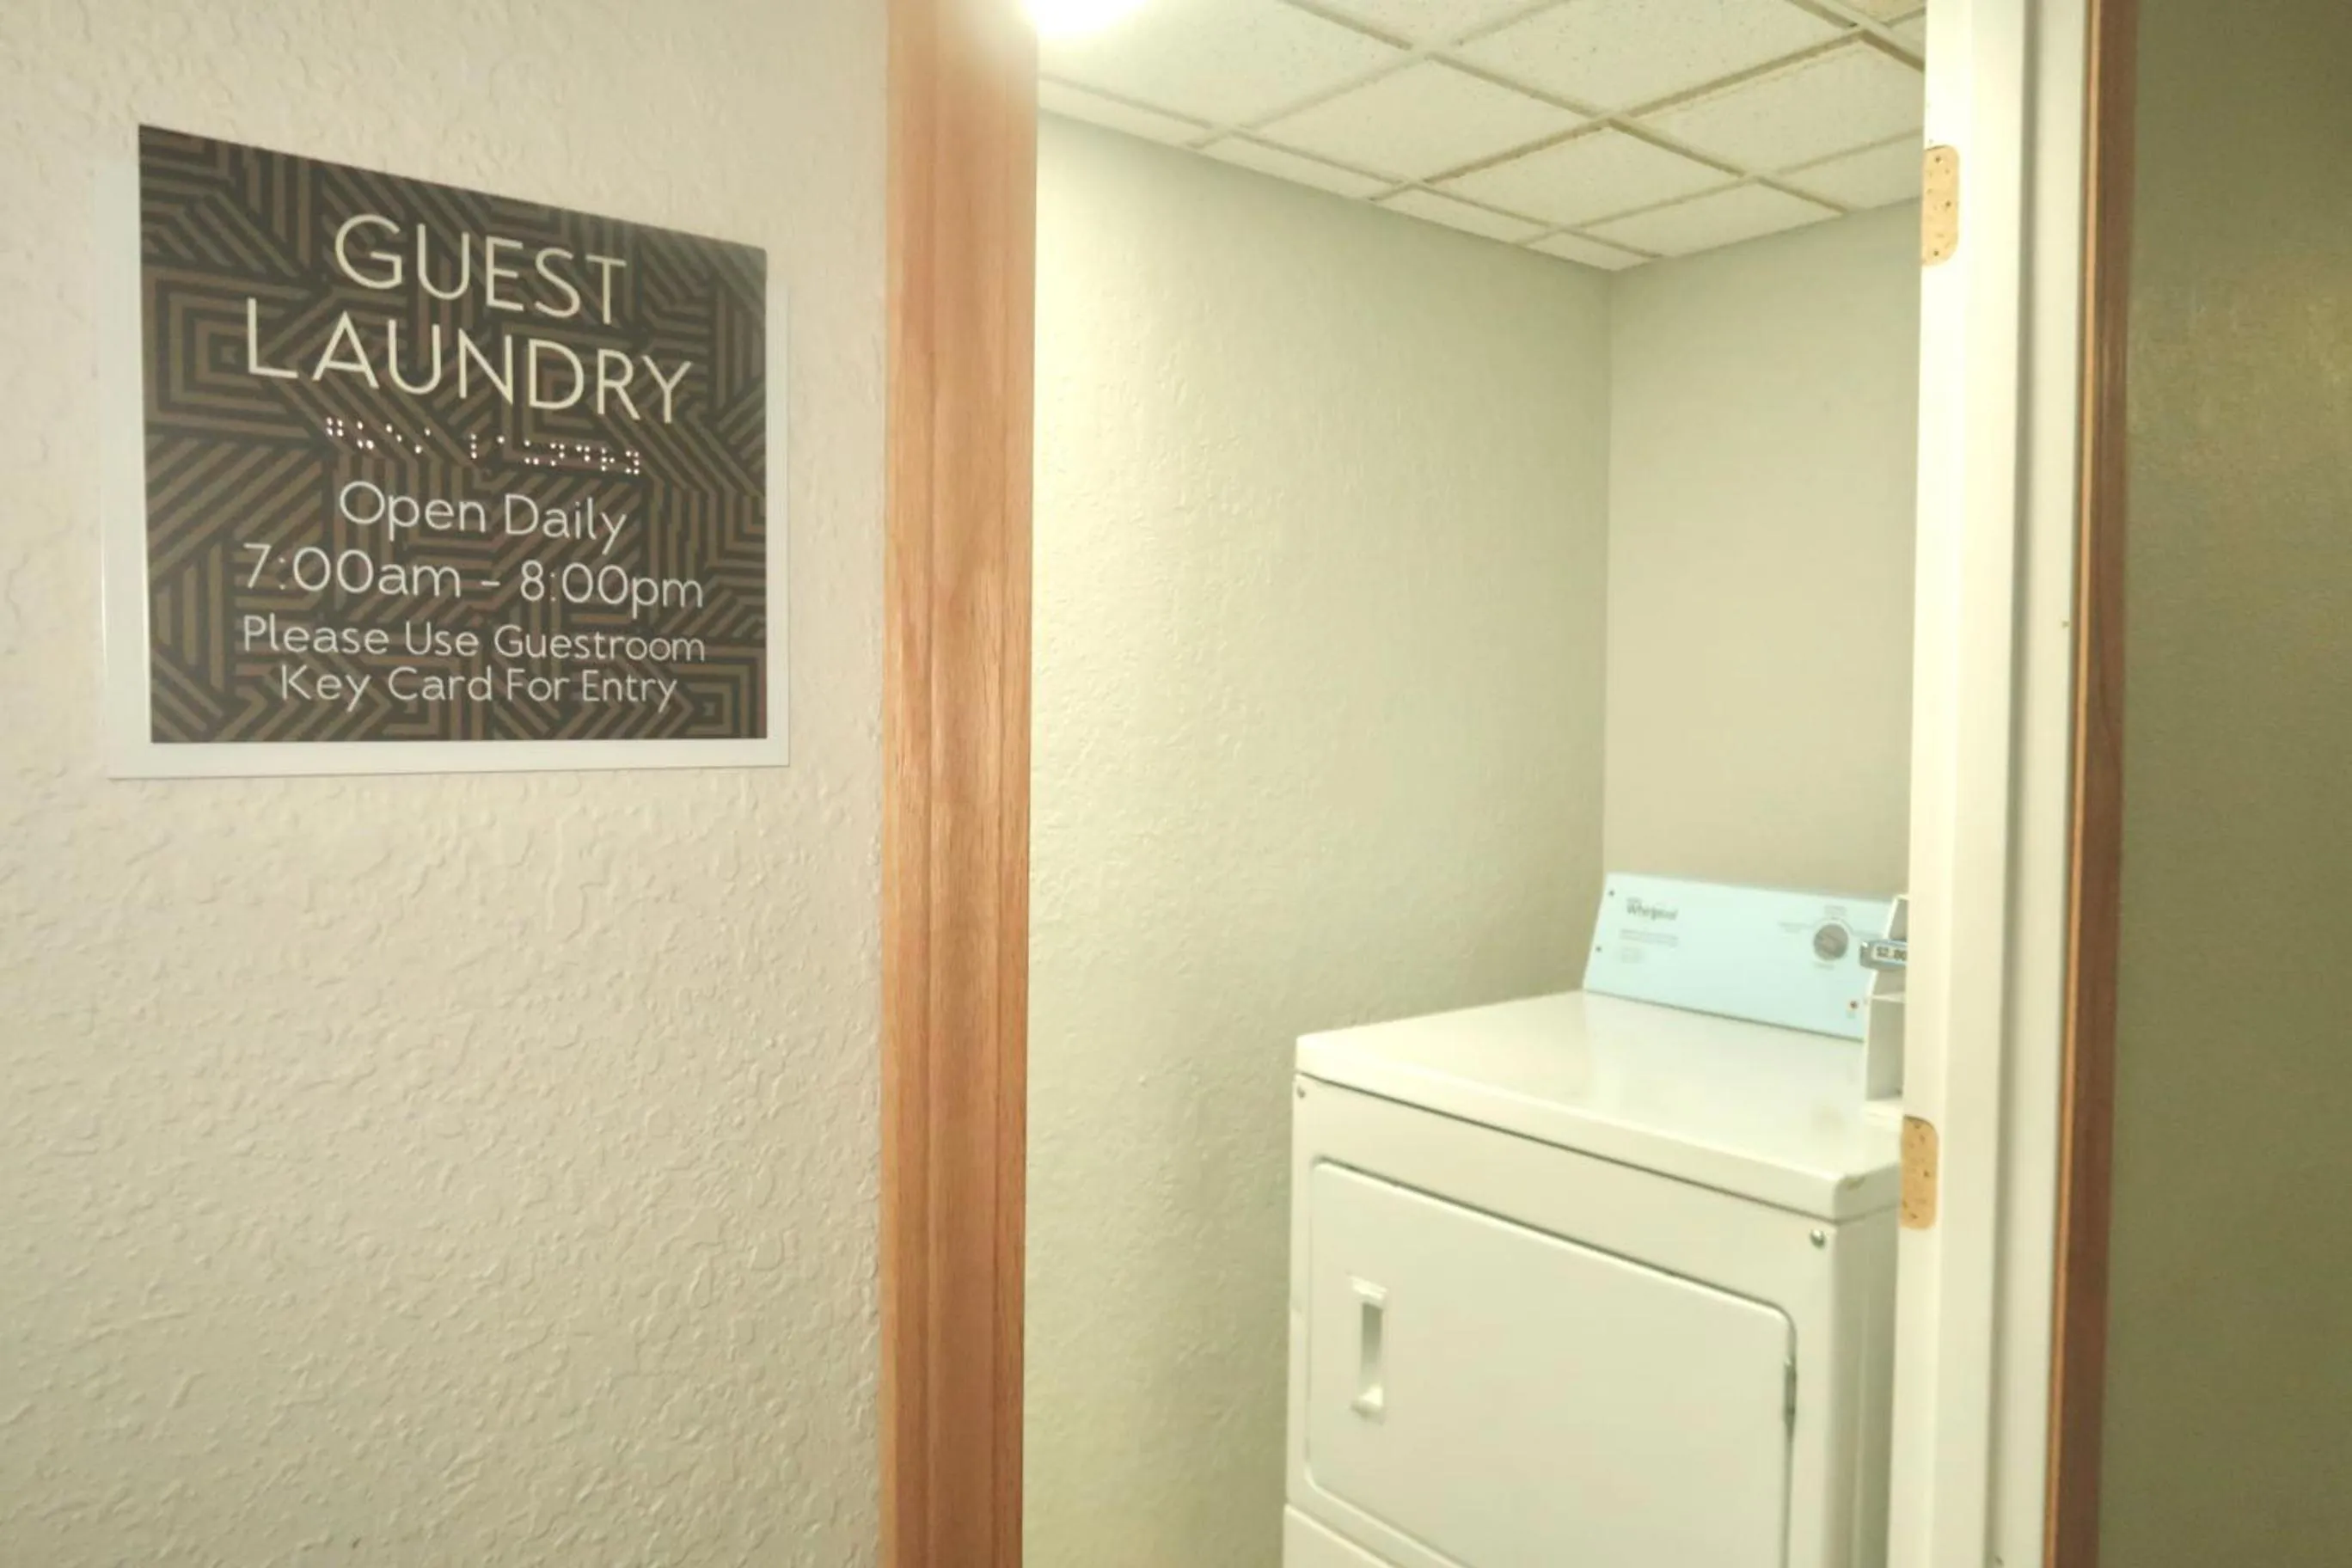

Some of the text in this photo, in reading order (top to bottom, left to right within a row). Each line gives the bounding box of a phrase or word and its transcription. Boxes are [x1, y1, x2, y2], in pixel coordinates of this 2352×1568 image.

[334, 212, 628, 325] GUEST
[246, 297, 693, 424] LAUNDRY
[339, 479, 628, 555] Open Daily
[242, 542, 462, 598] 7:00am
[519, 560, 704, 618] 8:00pm
[242, 614, 706, 662] Please Use Guestroom
[280, 664, 678, 714] Key Card For Entry
